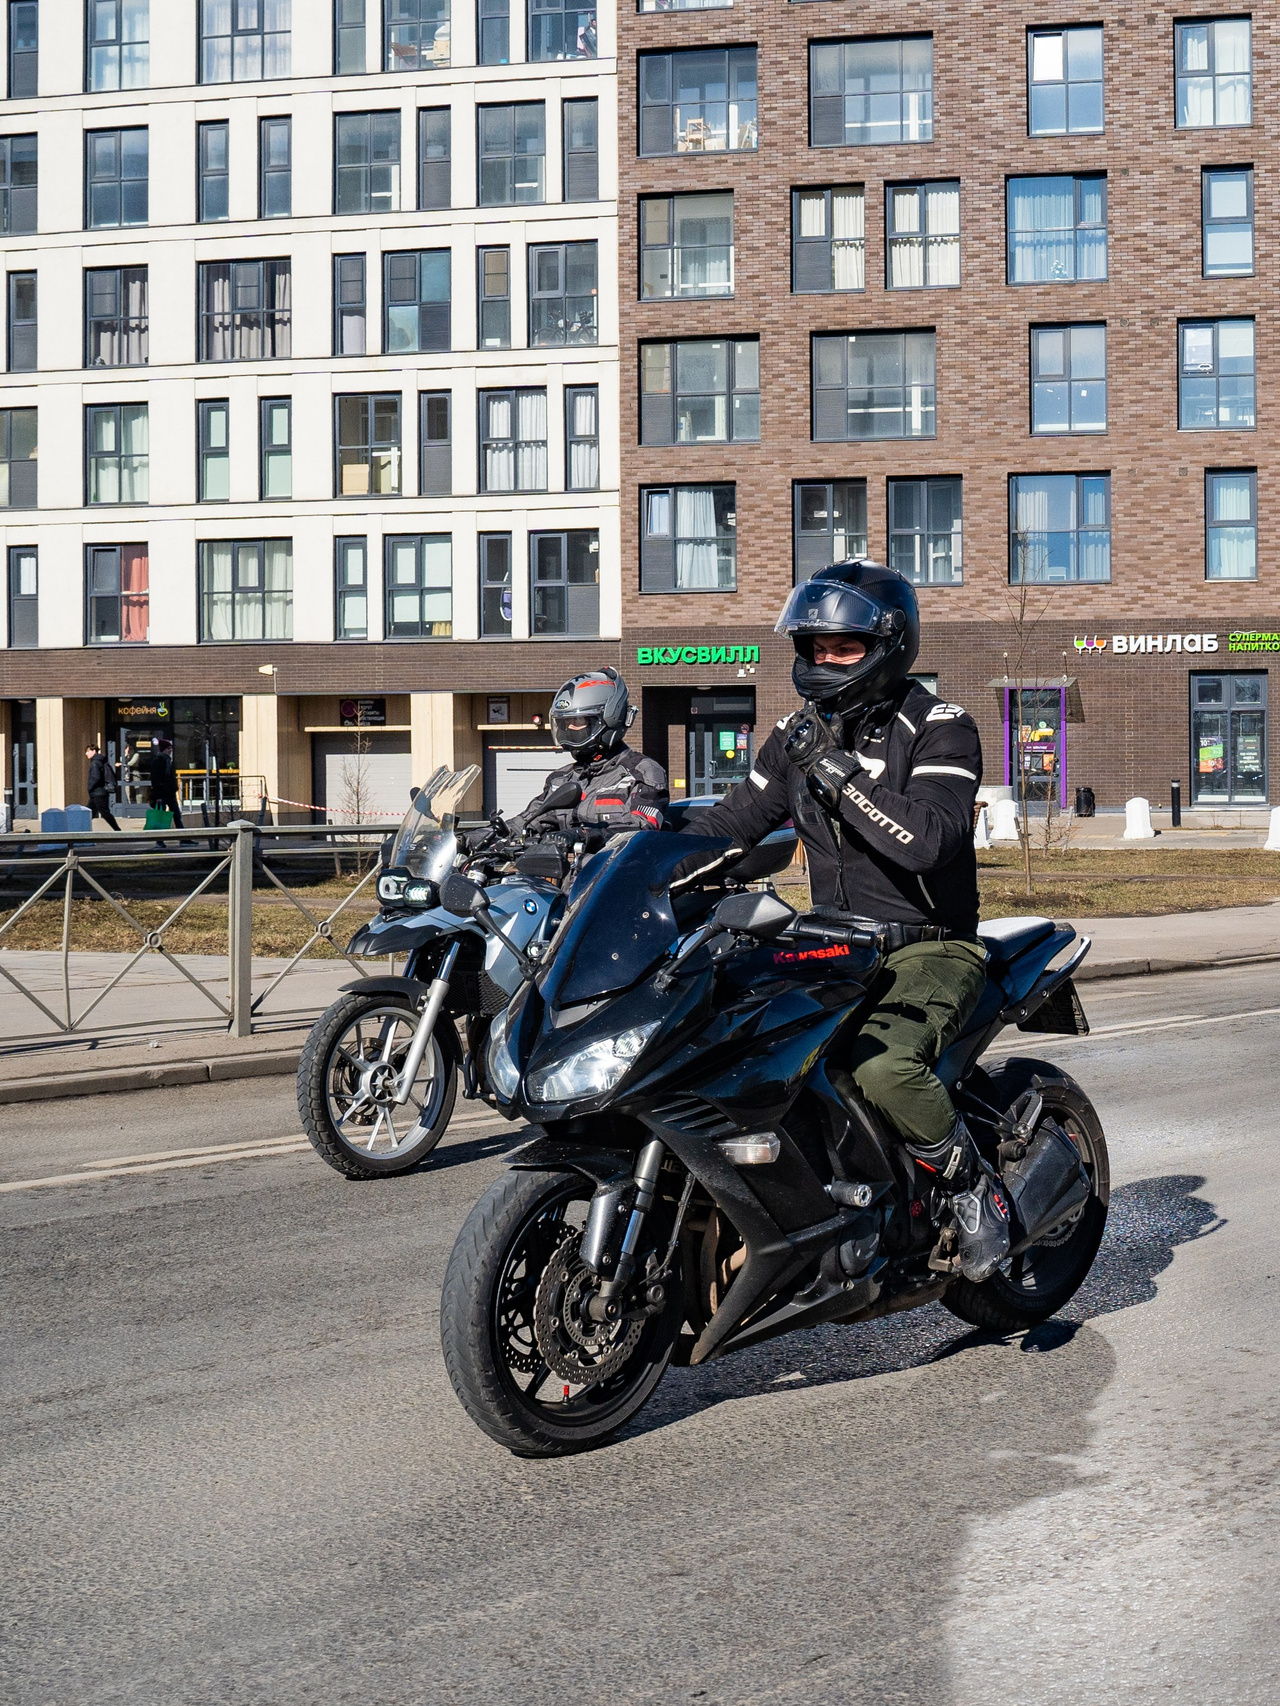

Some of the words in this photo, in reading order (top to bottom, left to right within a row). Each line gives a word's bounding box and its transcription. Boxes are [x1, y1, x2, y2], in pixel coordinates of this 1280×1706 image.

[1112, 634, 1219, 654] ВИНЛАБ
[637, 645, 760, 664] ВКУСВИЛЛ
[117, 706, 157, 716] кофейня
[772, 944, 851, 965] Kawasaki
